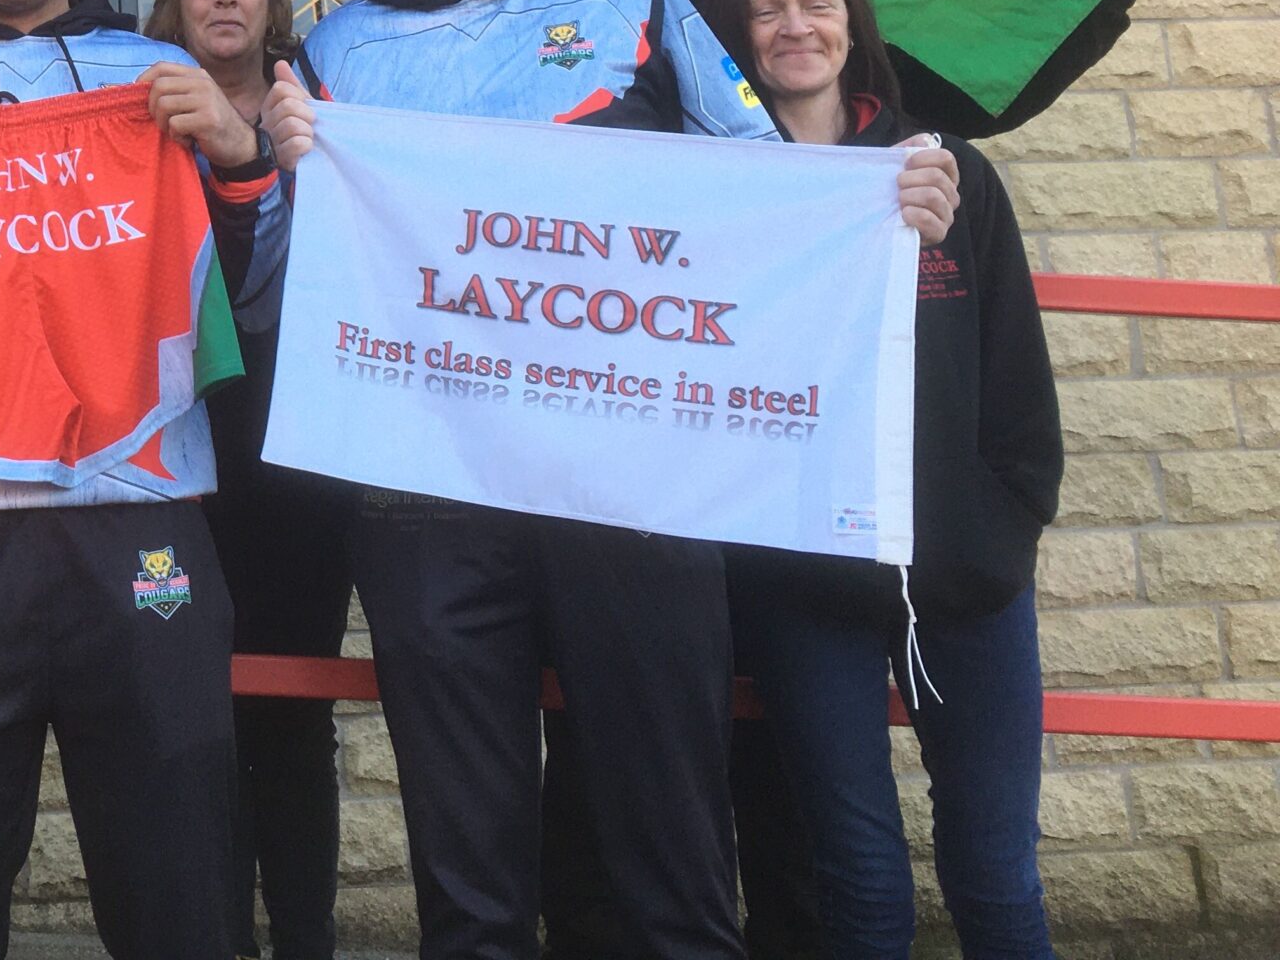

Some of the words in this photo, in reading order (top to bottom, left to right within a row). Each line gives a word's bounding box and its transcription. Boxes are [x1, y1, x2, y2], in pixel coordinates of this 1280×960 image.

[540, 49, 594, 67] COUGARS
[456, 208, 616, 260] JOHN
[628, 225, 691, 268] W.
[416, 266, 738, 346] LAYCOCK
[335, 321, 417, 367] First
[423, 340, 513, 381] class
[524, 361, 662, 401] service
[672, 371, 715, 406] in
[726, 383, 821, 418] steel
[135, 585, 192, 609] COUGARS
